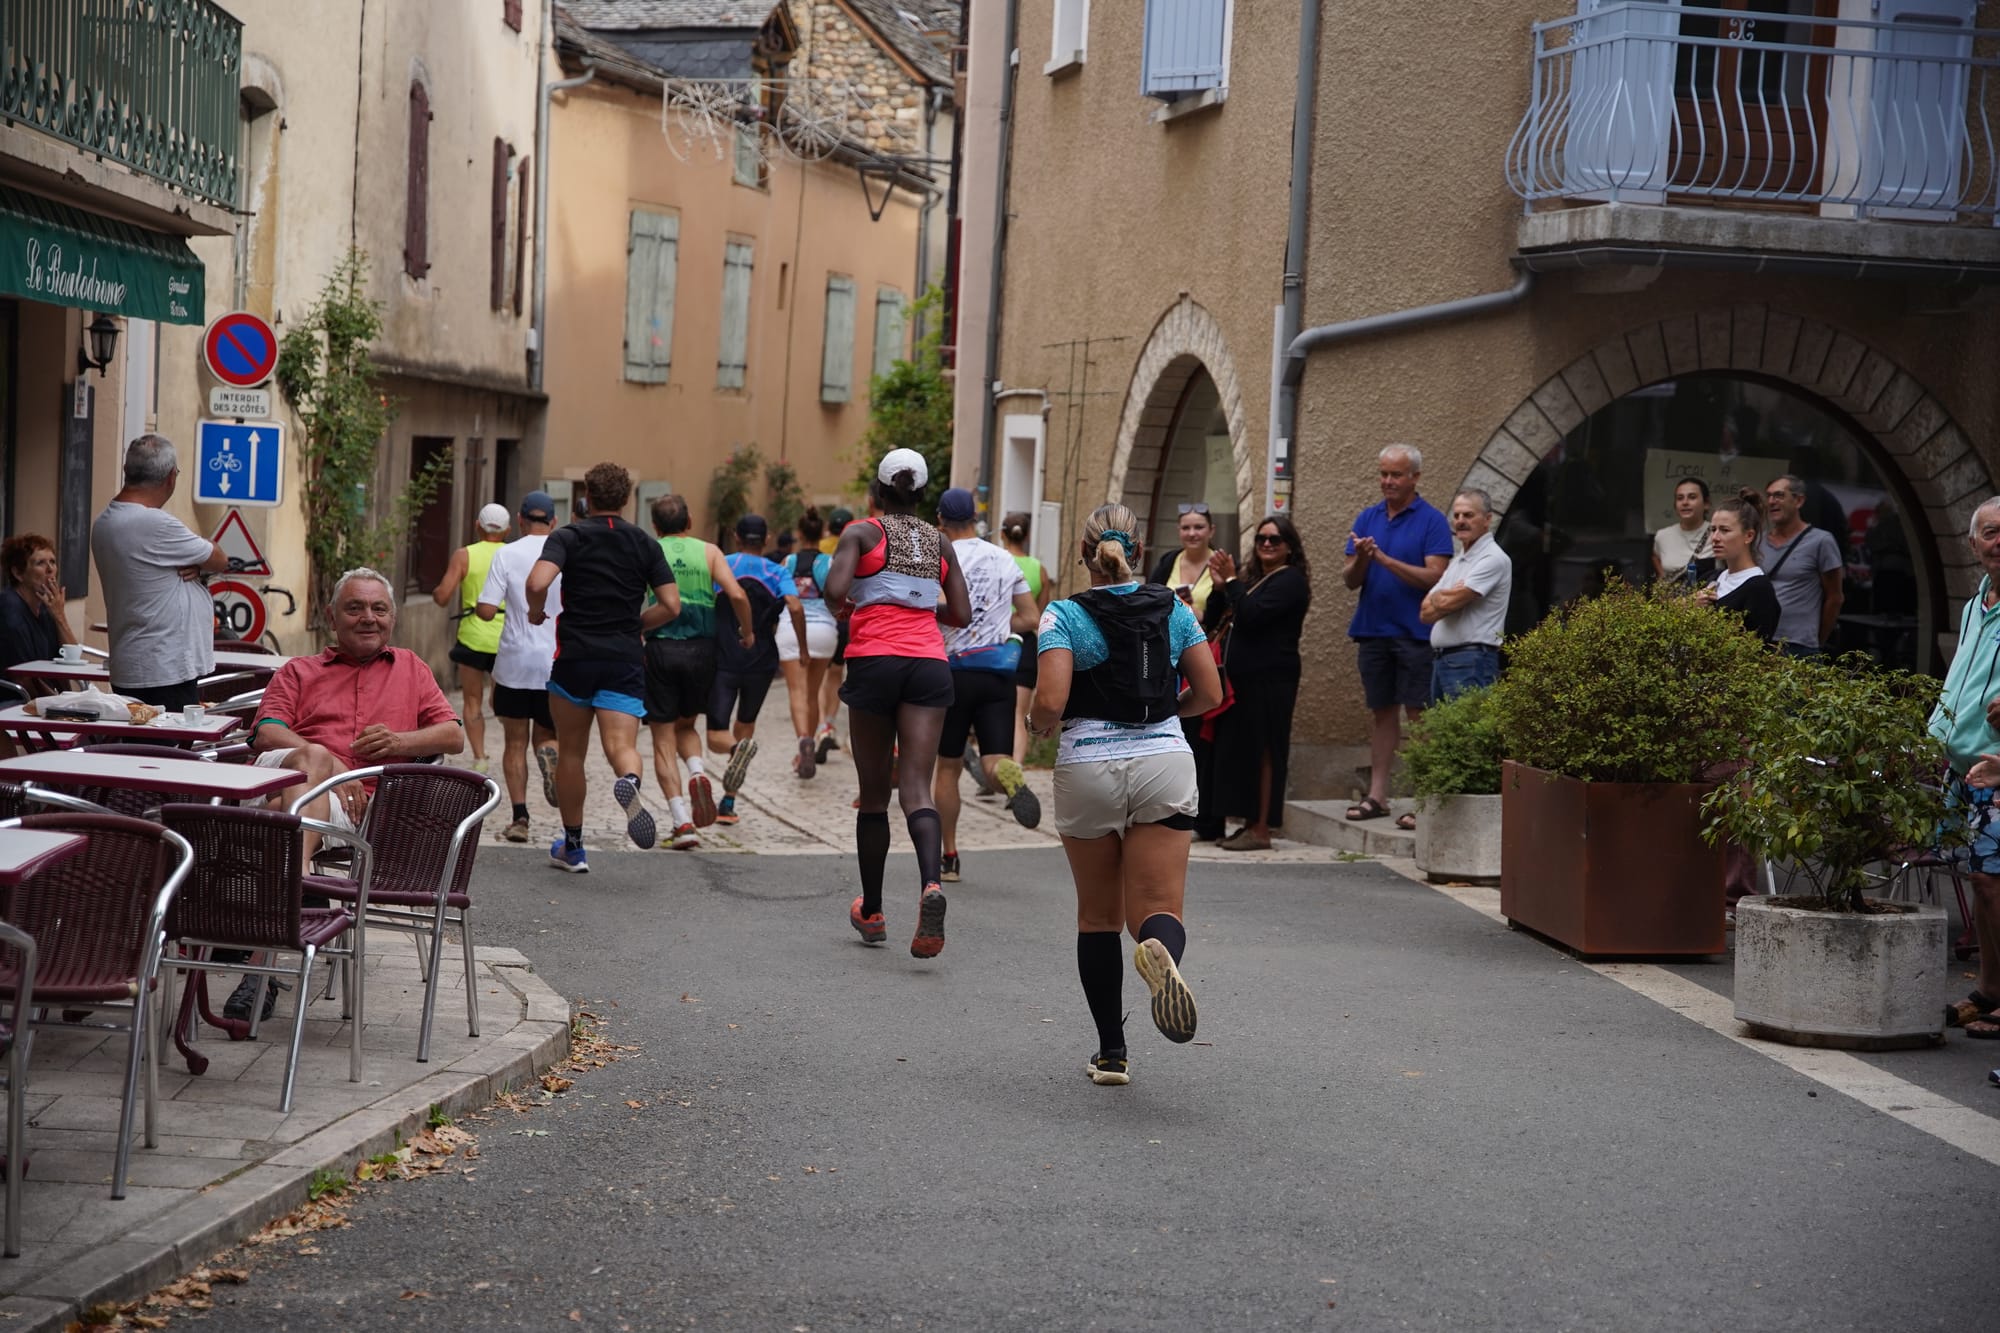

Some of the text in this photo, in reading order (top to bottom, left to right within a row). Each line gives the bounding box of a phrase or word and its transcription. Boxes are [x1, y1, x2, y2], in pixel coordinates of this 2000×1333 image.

[25, 237, 128, 306] Le Boulodrome
[220, 392, 260, 403] INTERDIT
[213, 403, 230, 412] DES
[232, 404, 238, 412] 2
